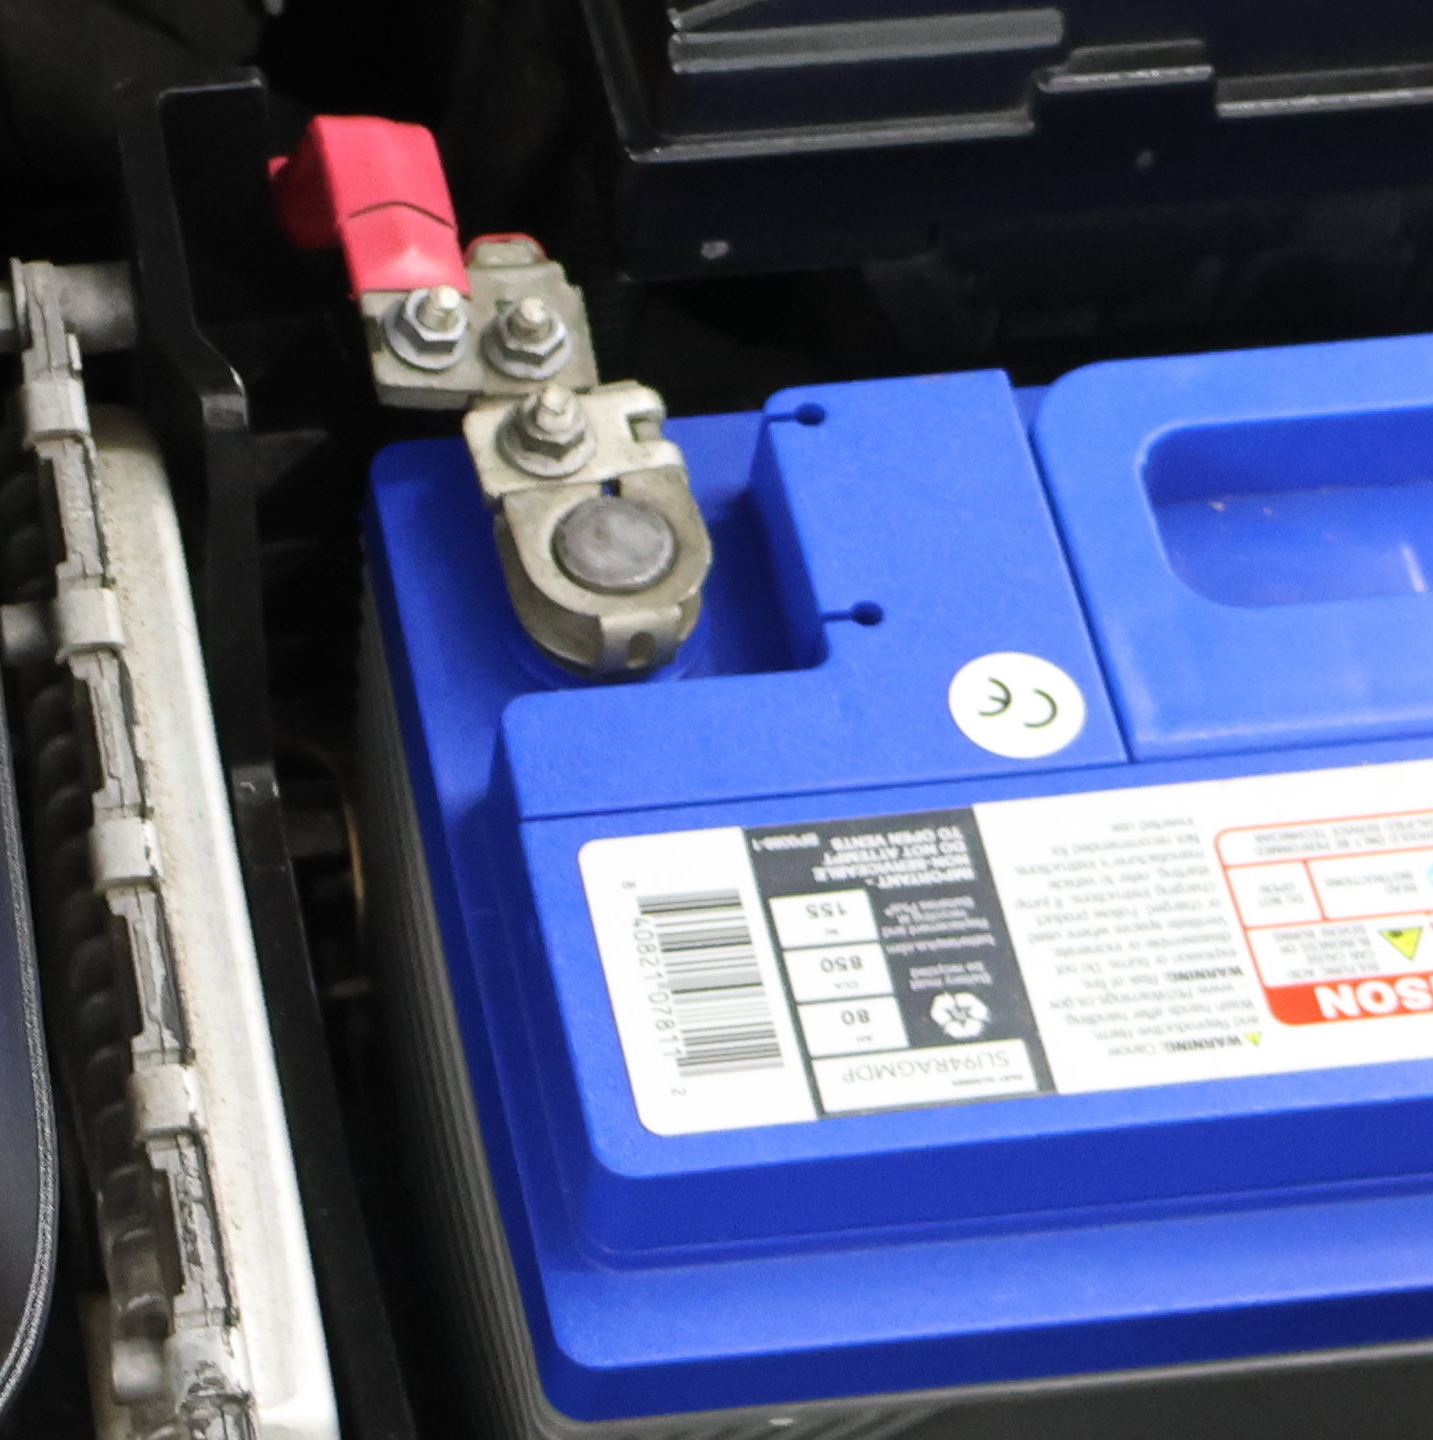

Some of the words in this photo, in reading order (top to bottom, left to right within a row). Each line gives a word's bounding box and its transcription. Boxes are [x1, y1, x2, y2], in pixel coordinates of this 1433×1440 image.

[886, 828, 936, 845] OPEN
[936, 825, 962, 840] TO
[829, 833, 886, 850] VENTS
[899, 840, 938, 857] NOT
[937, 838, 966, 853] DO
[819, 844, 900, 865] ATTEMPT
[877, 866, 975, 888] IMPORTANT
[805, 902, 846, 918] 155
[819, 954, 863, 973] 850
[1110, 976, 1124, 988] of
[1165, 965, 1243, 982] WARNING:
[630, 914, 663, 981] 40821
[647, 990, 683, 1058] 07811
[1131, 1006, 1163, 1020] after
[1167, 1001, 1211, 1016] hands
[1214, 997, 1255, 1012] Wash
[839, 1008, 870, 1025] 80
[1137, 1018, 1230, 1036] Reproductive
[1106, 1042, 1156, 1057] Cancer
[1162, 1034, 1241, 1052] WARNING:
[840, 1050, 1009, 1083] SLI94RAGMDP
